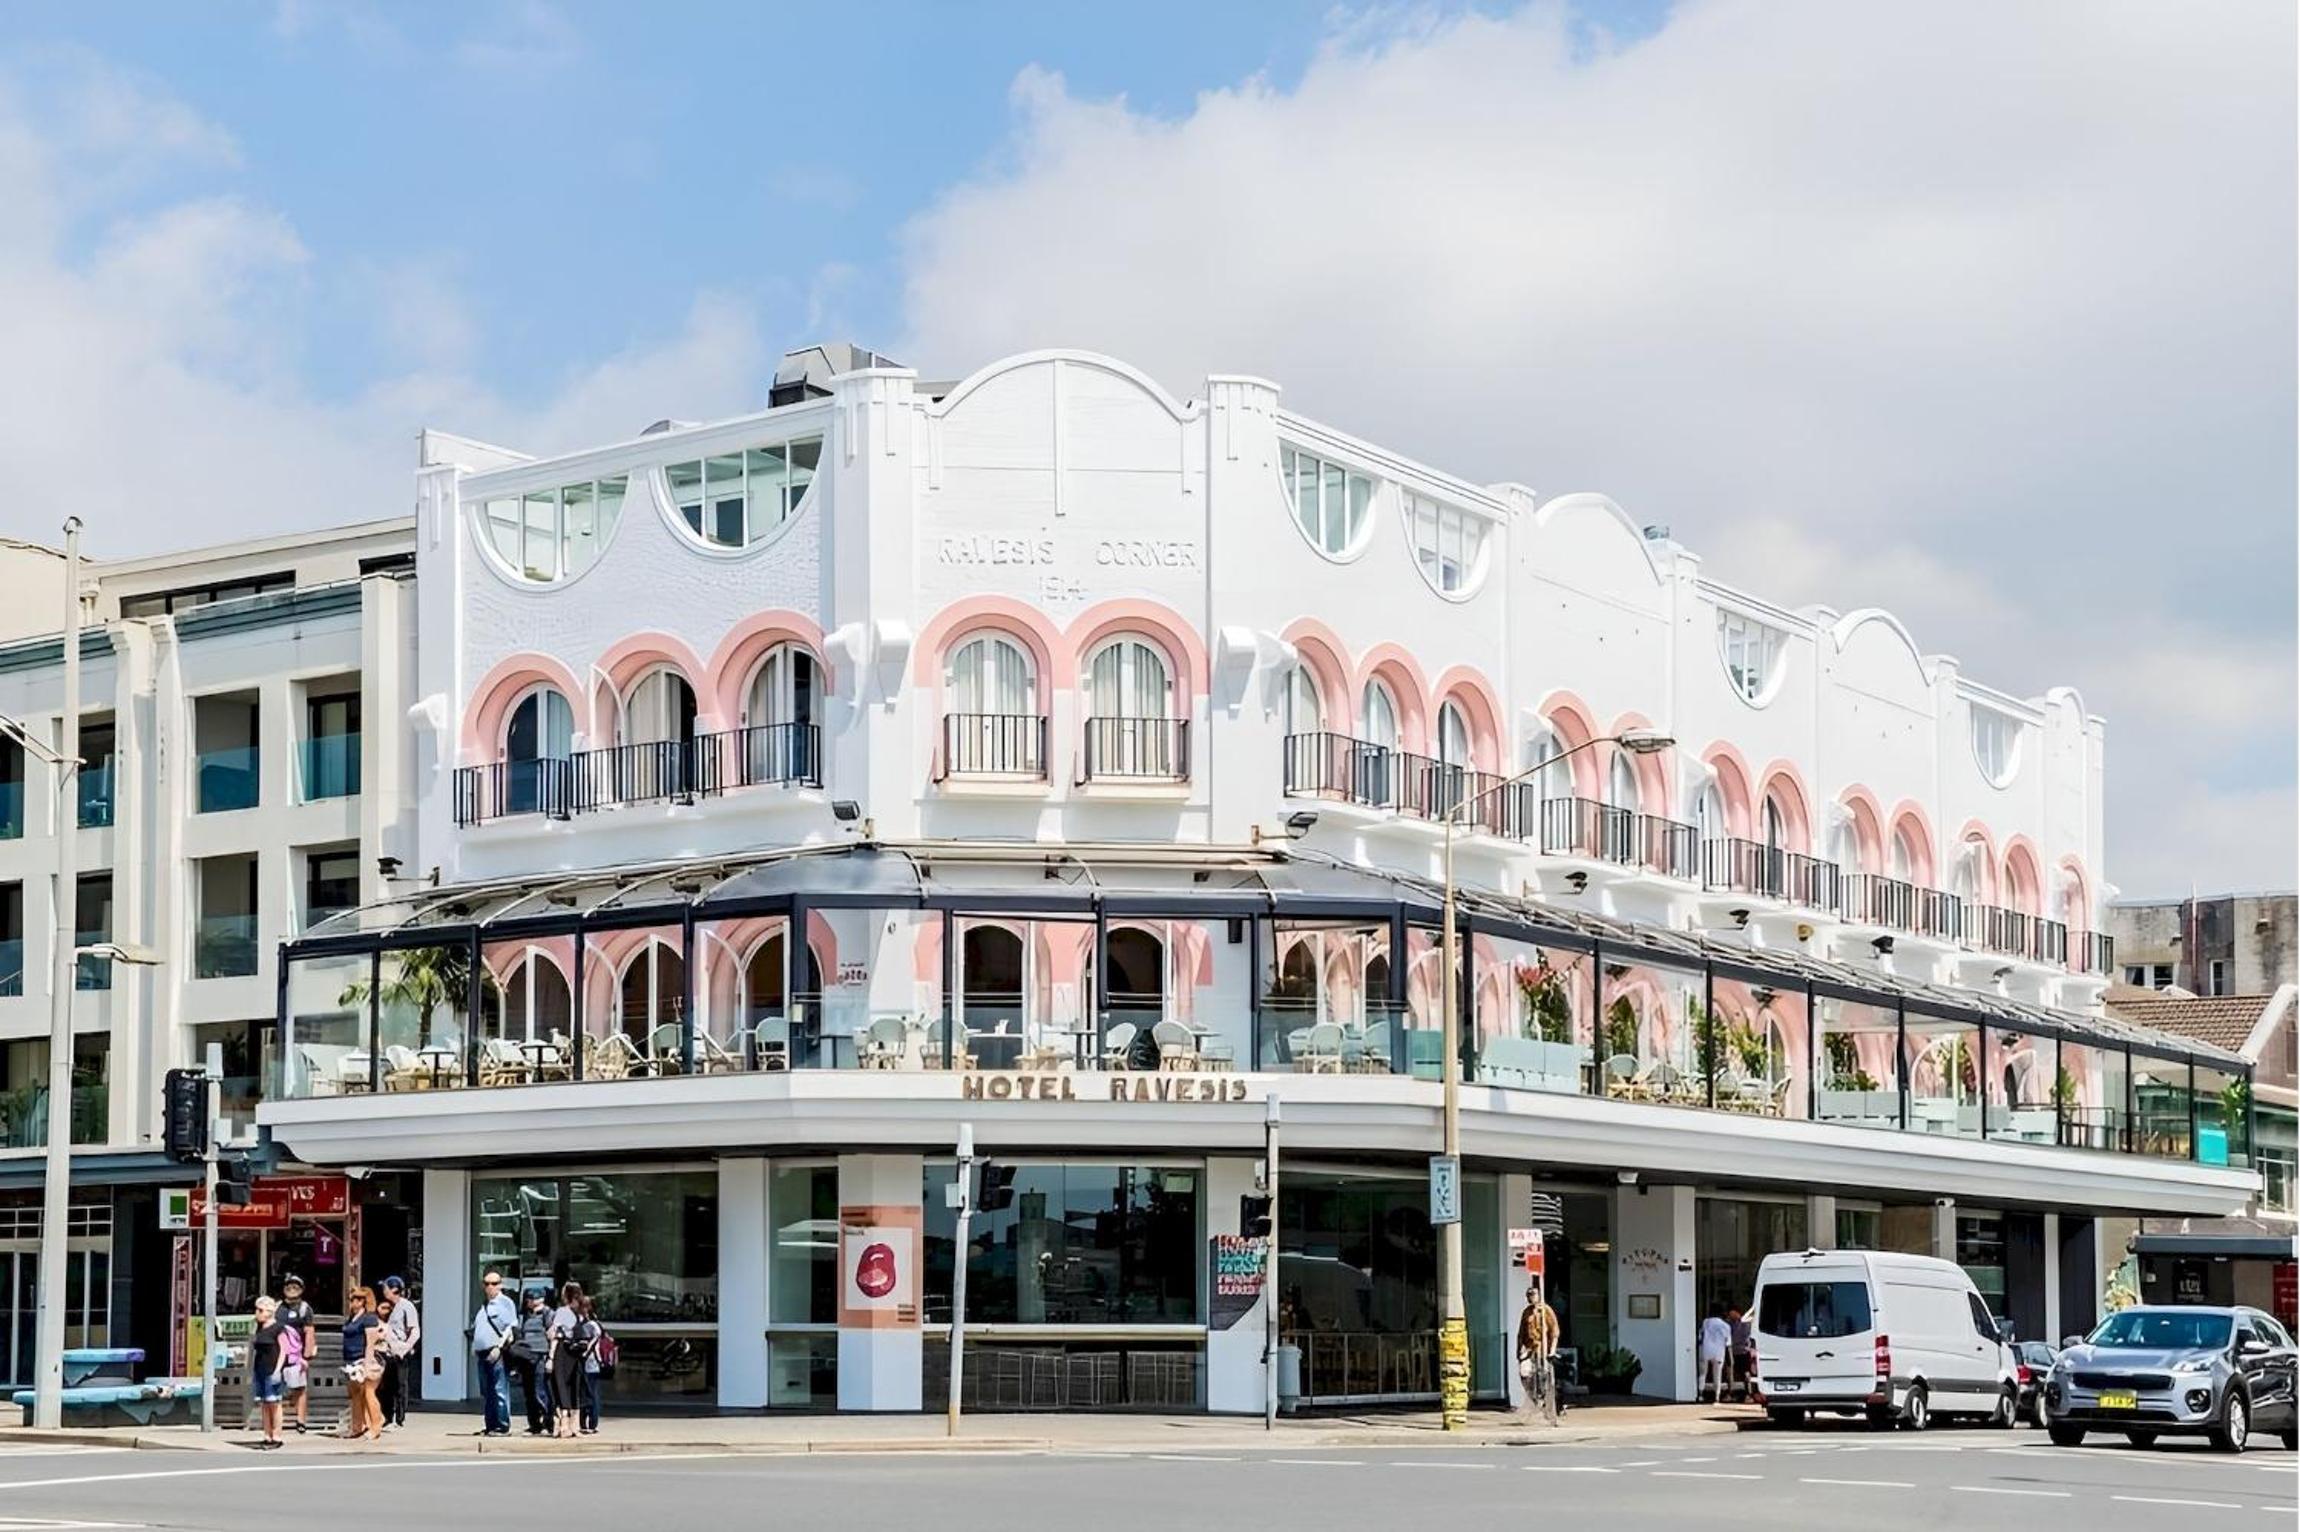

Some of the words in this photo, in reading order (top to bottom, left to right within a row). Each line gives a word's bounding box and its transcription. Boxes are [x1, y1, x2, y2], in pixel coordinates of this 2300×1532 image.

[1095, 540, 1197, 567] CORNER
[962, 1075, 1076, 1100] HOTEL
[1111, 1076, 1248, 1102] RAVESIS
